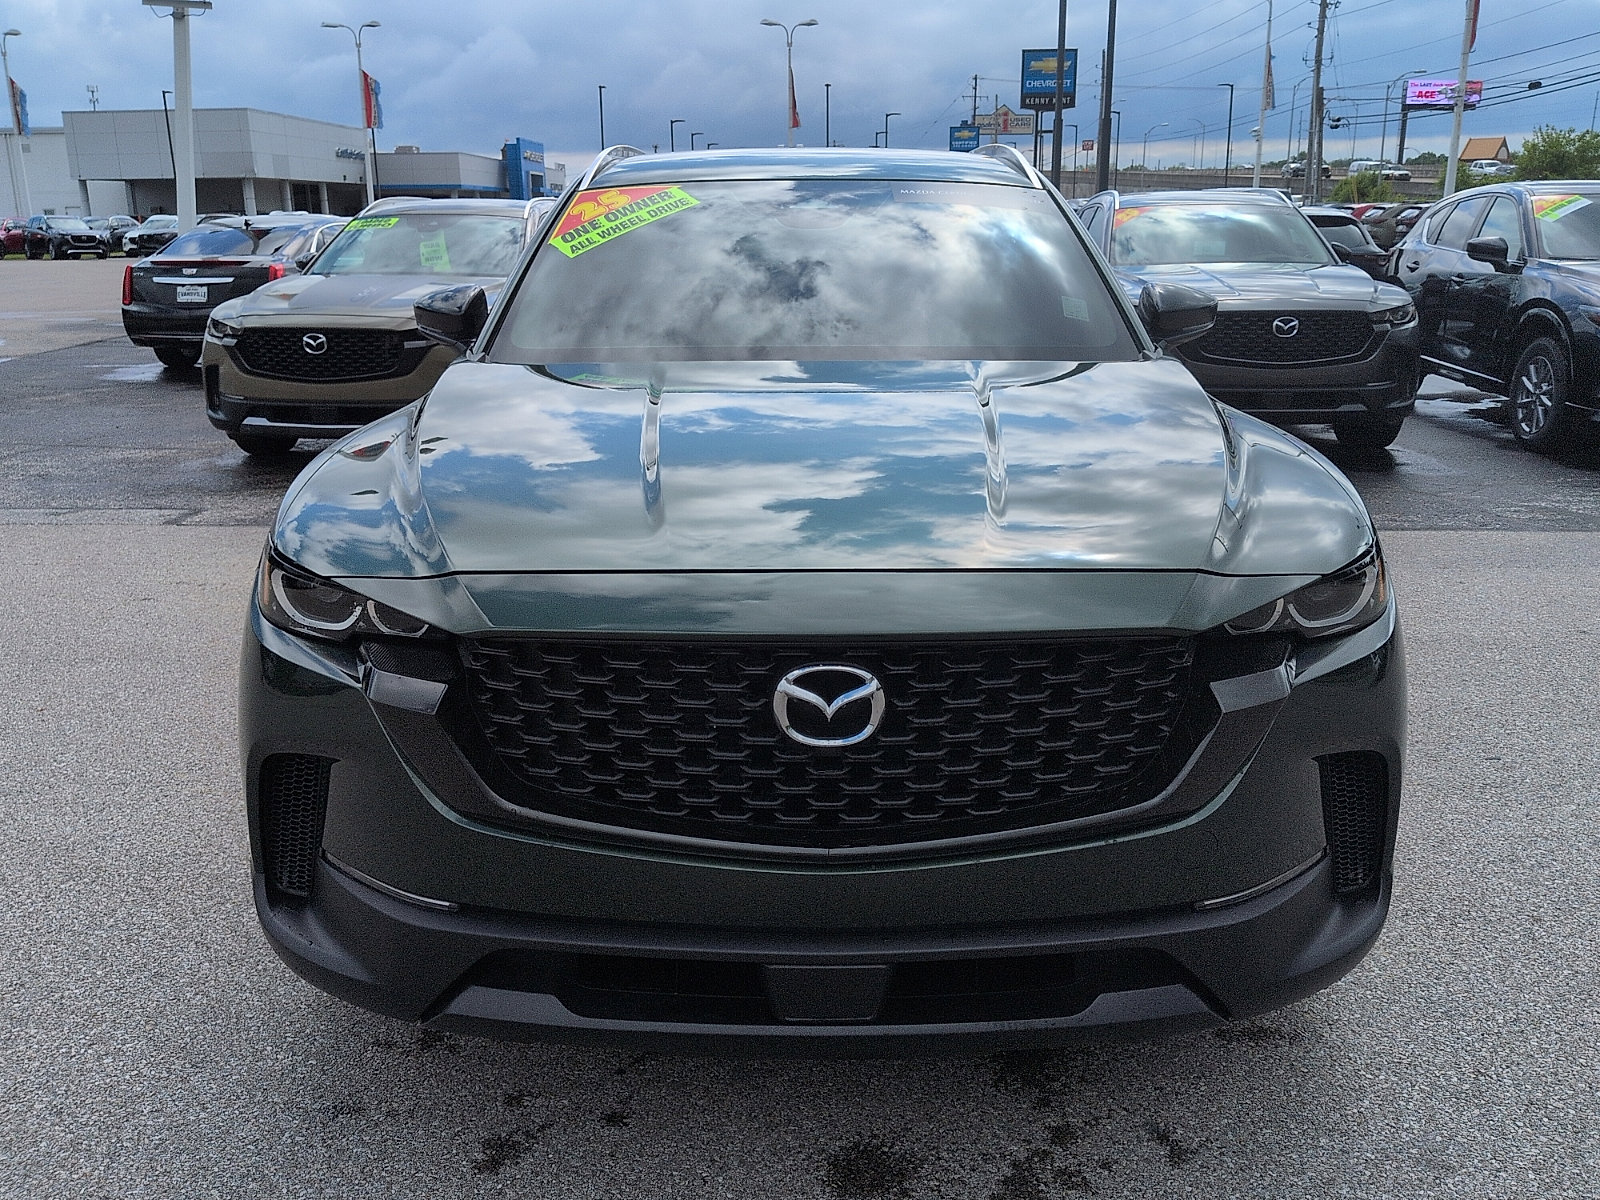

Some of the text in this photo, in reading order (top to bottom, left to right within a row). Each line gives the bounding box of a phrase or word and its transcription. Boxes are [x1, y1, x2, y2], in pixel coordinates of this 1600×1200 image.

[1026, 80, 1071, 88] CHEVROET
[1025, 97, 1050, 105] KENNY
[560, 191, 676, 244] ONE OWNER
[570, 189, 631, 222] 25
[570, 197, 693, 254] ALL WHEEL DRIVE
